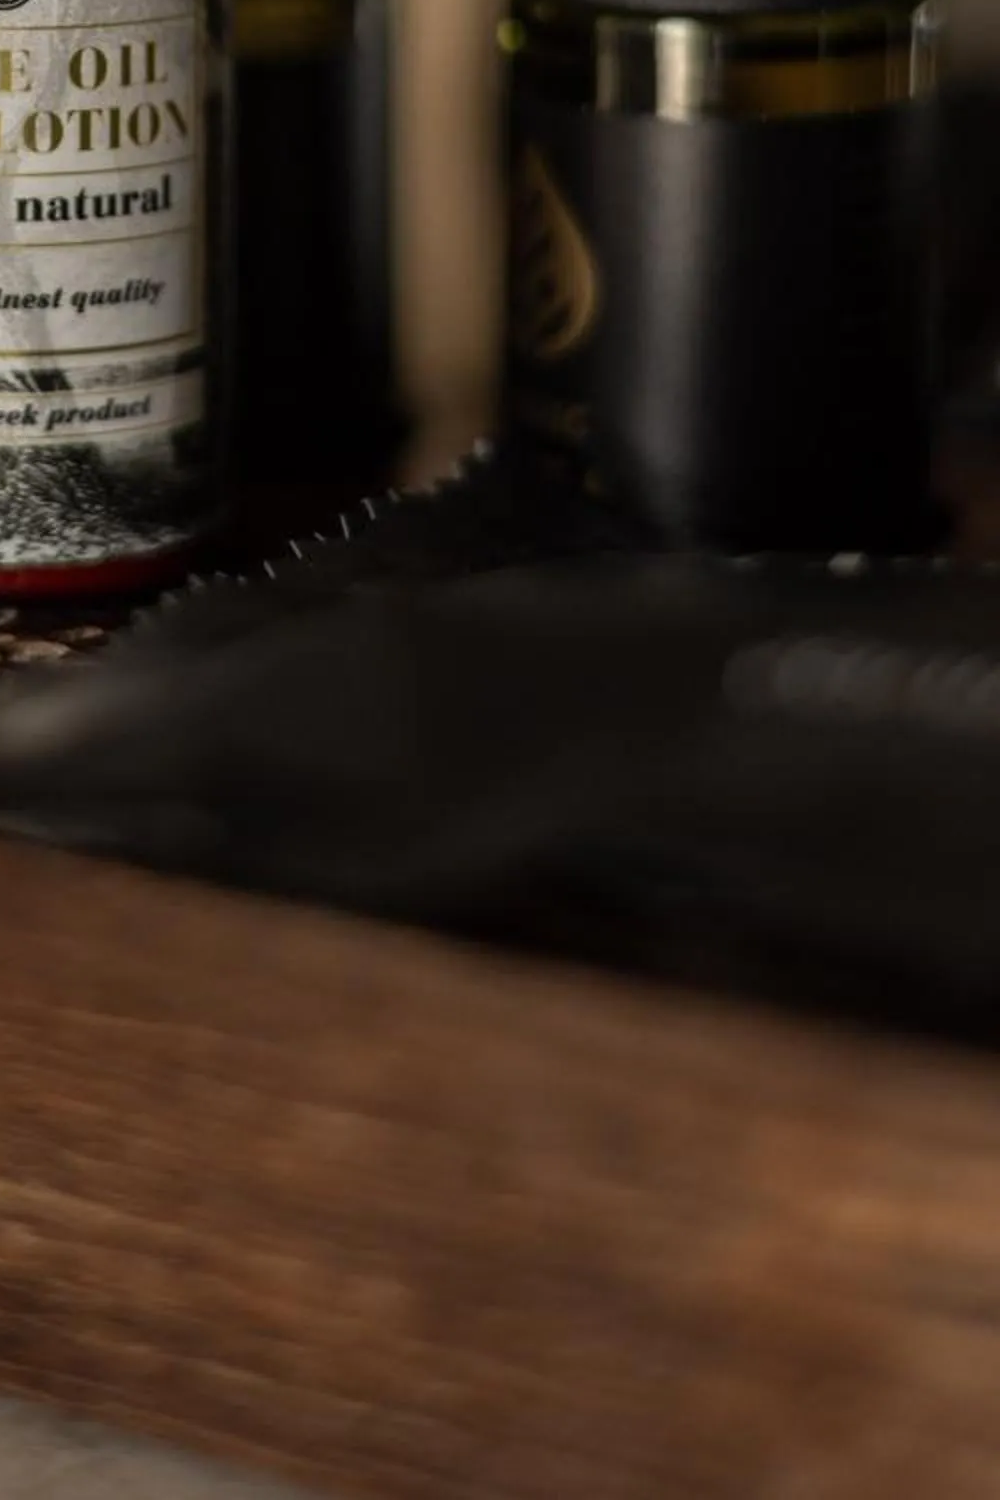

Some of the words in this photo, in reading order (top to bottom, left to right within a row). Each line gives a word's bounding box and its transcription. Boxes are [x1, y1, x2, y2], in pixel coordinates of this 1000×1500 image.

[69, 41, 168, 91] OIL
[16, 174, 172, 222] natural
[70, 279, 166, 314] quality
[45, 394, 152, 430] product
